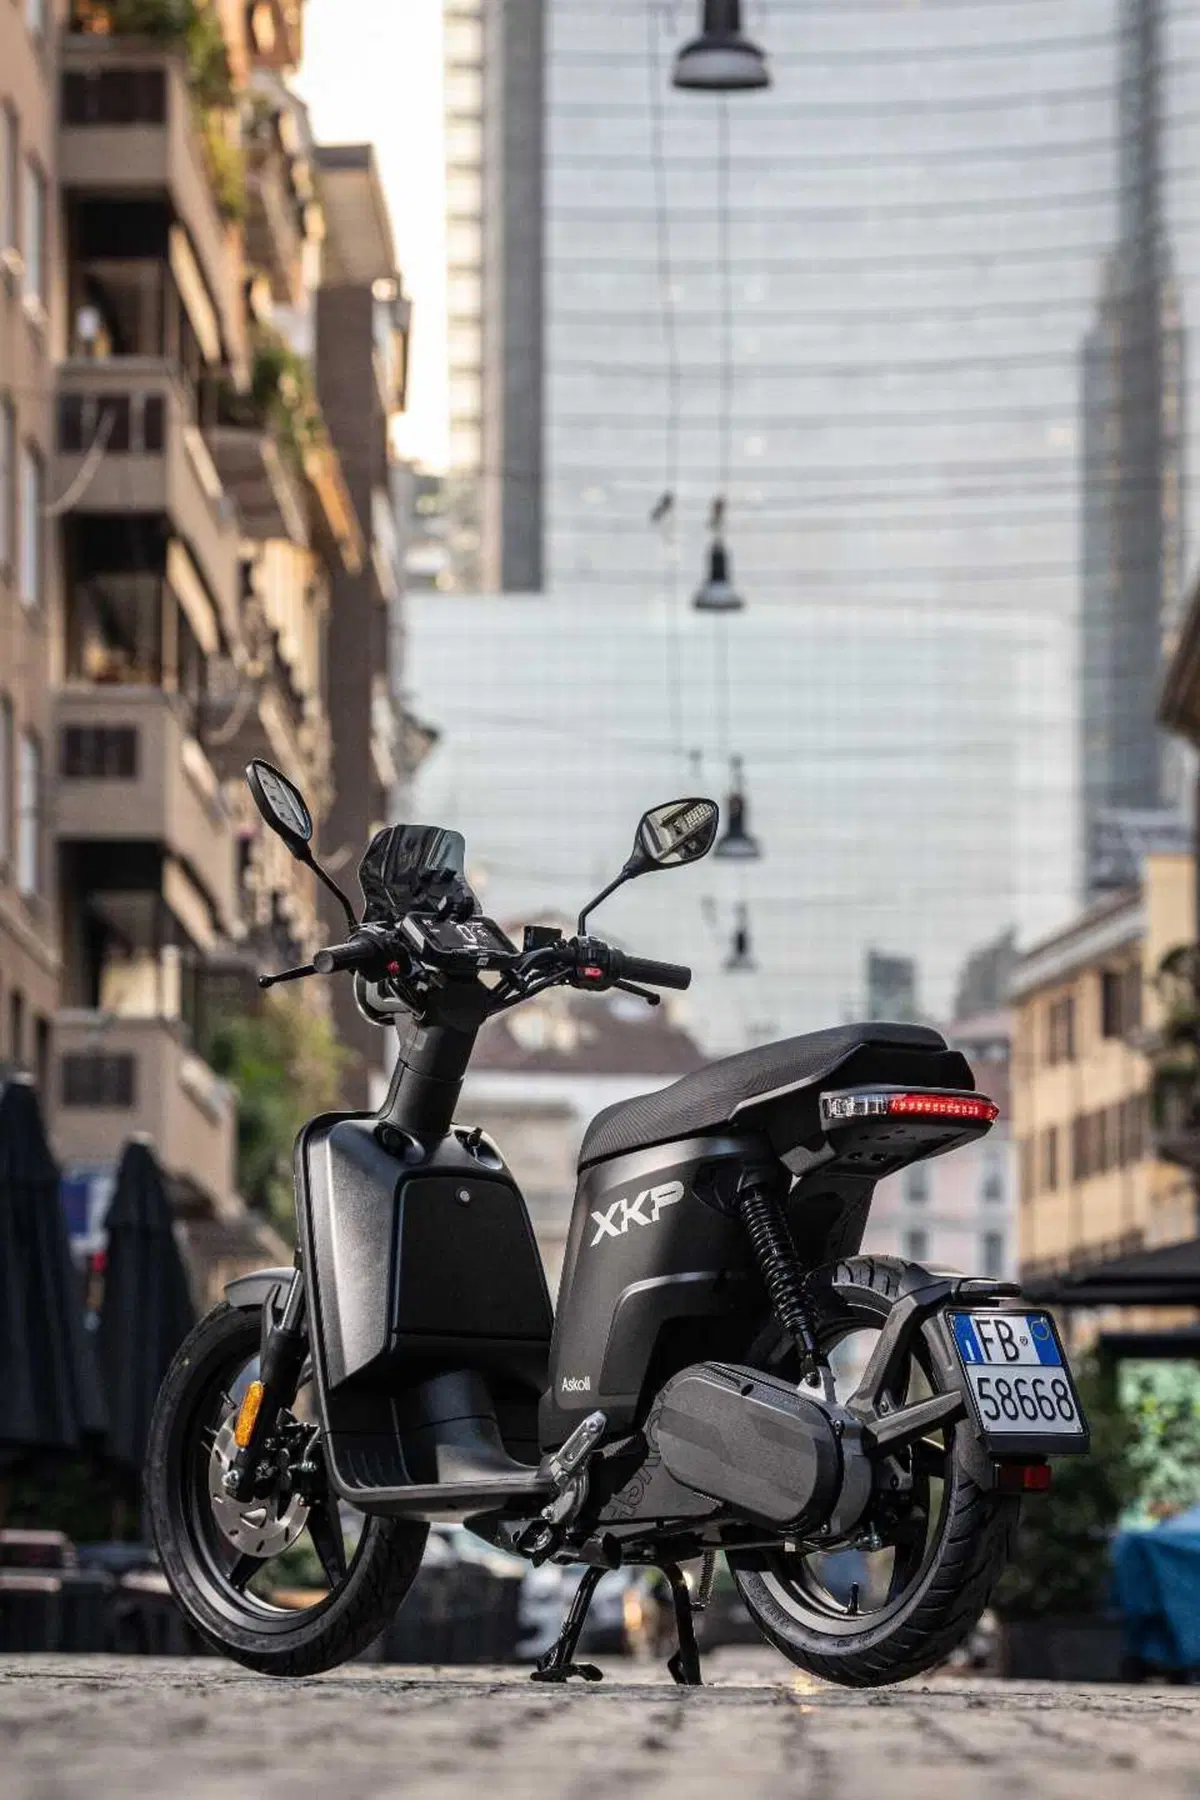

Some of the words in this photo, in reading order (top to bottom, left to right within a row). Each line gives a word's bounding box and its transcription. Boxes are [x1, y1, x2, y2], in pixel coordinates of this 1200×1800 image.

[590, 1180, 685, 1247] XKP
[974, 1319, 1020, 1361] FB
[561, 1376, 591, 1392] Askoll
[977, 1377, 1074, 1421] 58668
